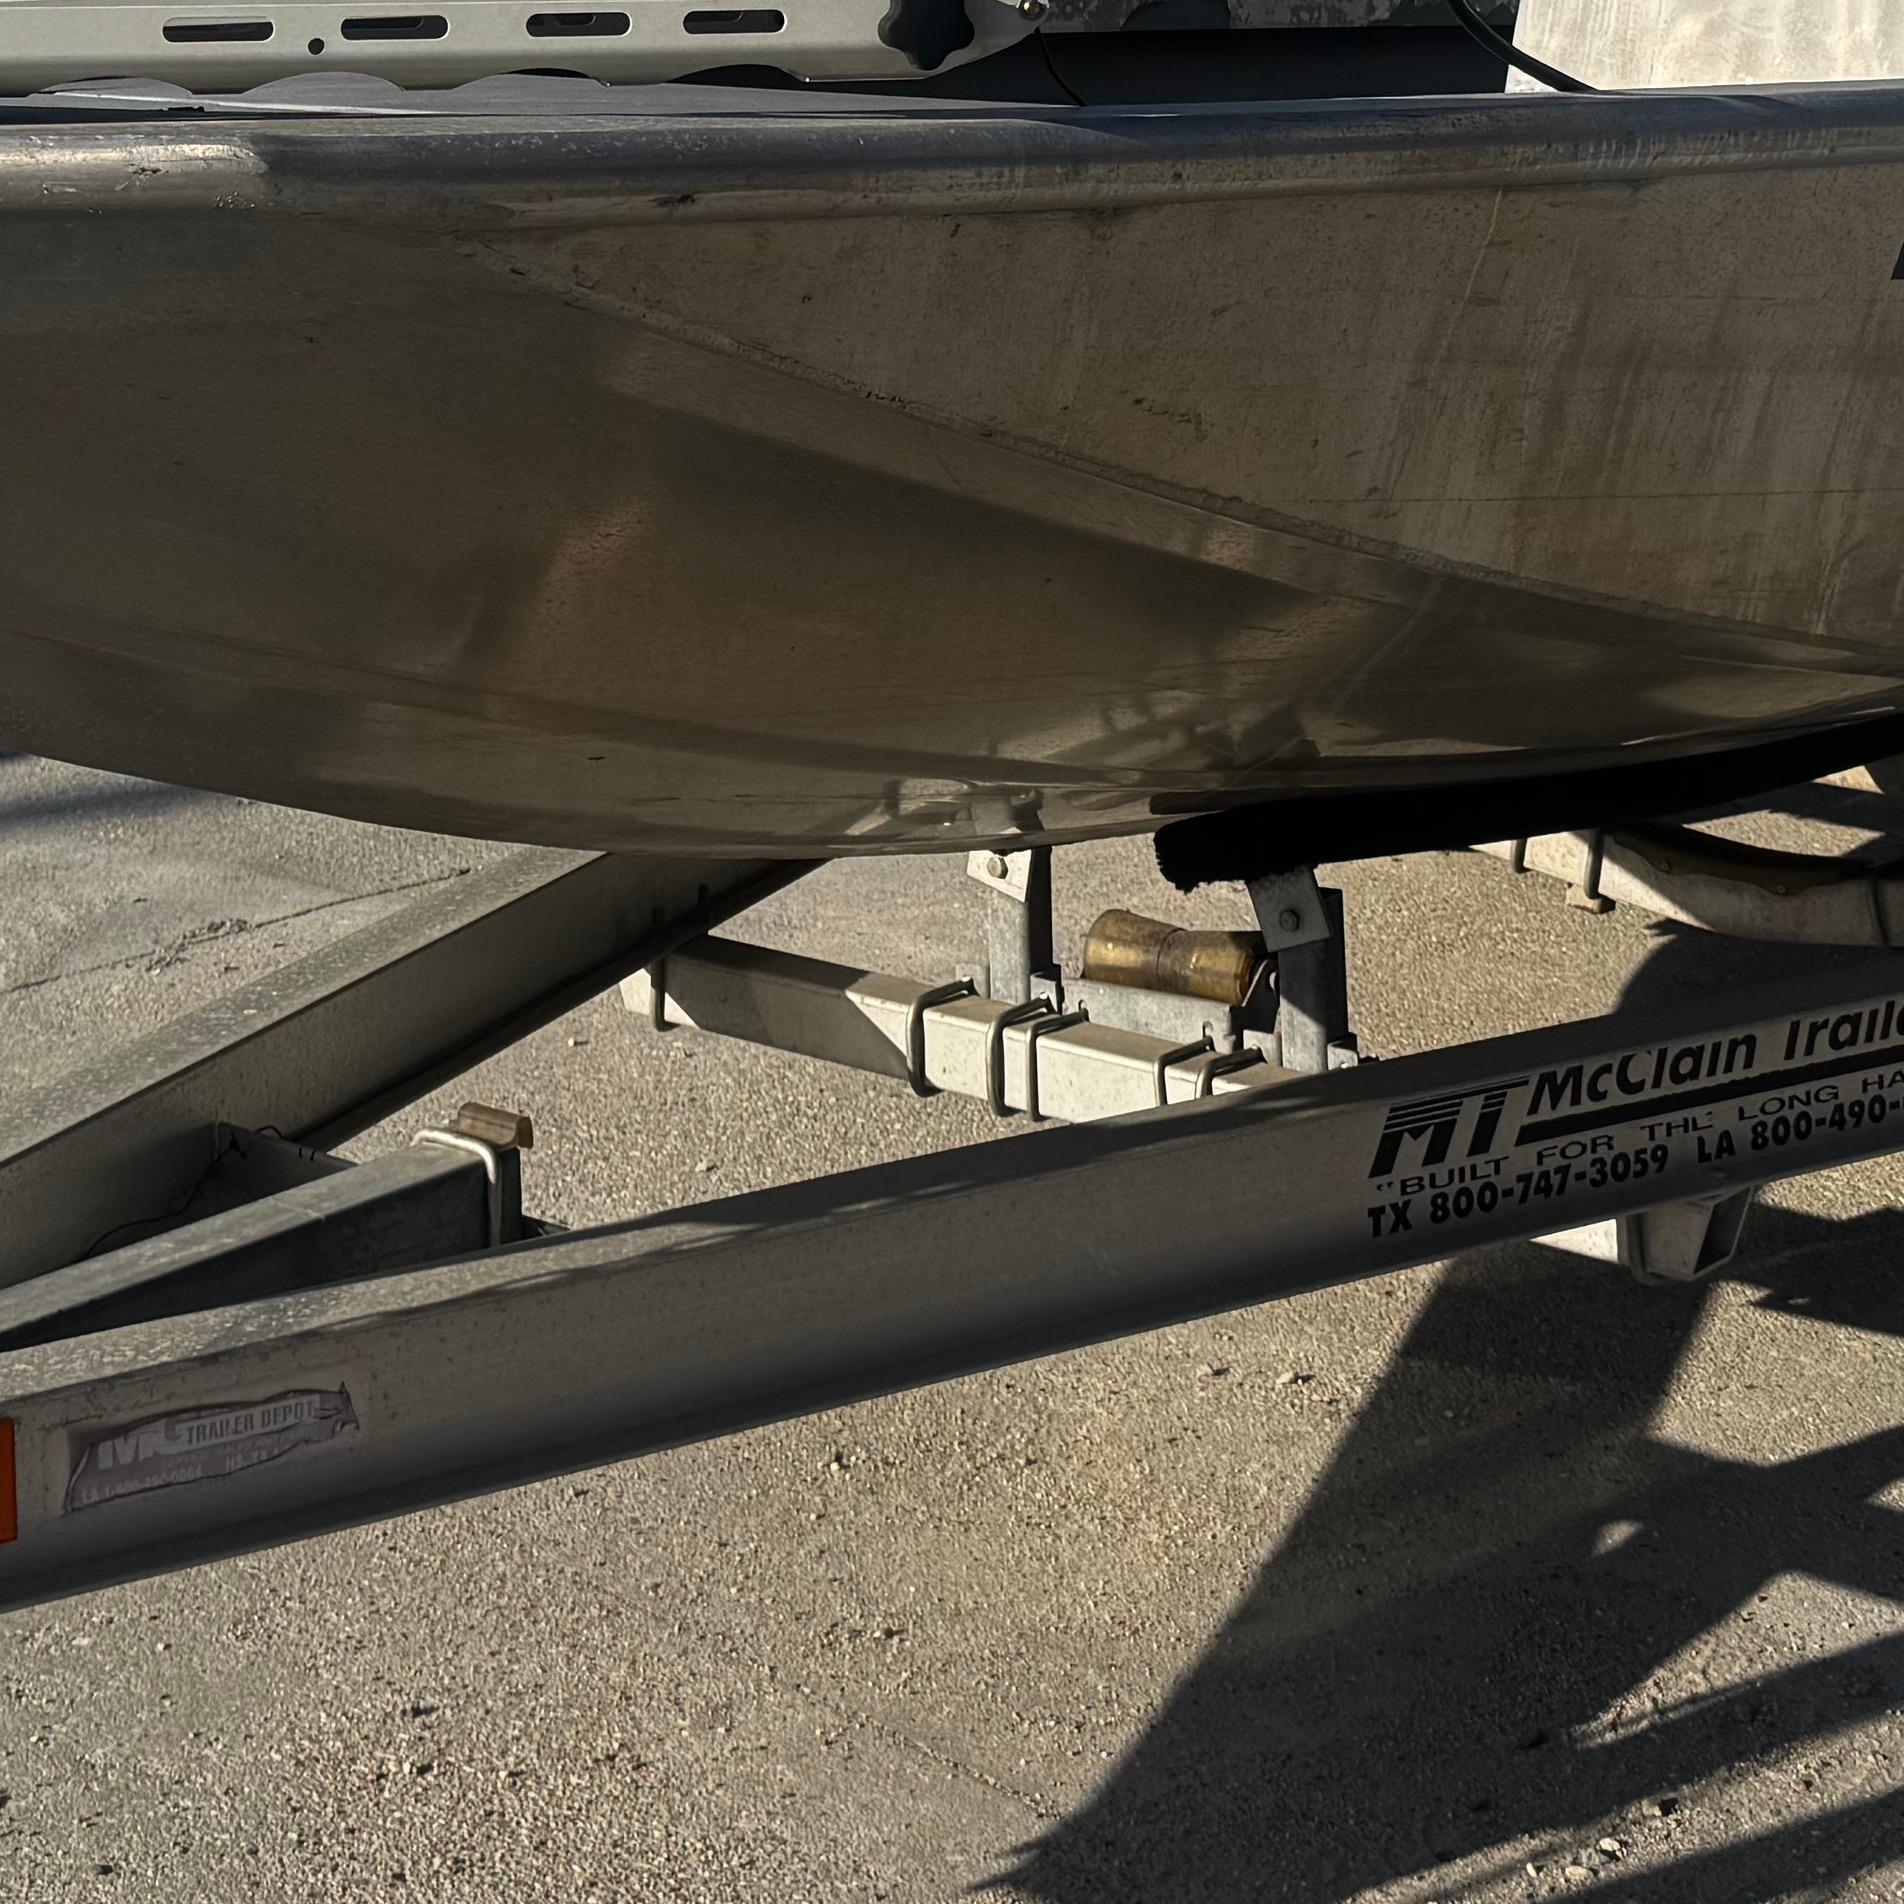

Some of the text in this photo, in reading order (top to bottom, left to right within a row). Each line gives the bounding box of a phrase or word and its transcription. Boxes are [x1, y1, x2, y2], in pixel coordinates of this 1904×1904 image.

[1526, 1033, 1758, 1117] McClain
[1536, 1134, 1615, 1166] FOR
[1738, 1084, 1840, 1121] LONG
[1367, 1198, 1413, 1238] TX
[1429, 1143, 1670, 1225] 800-747-3059
[1696, 1129, 1737, 1164] LA
[185, 1410, 255, 1446] TRAILER
